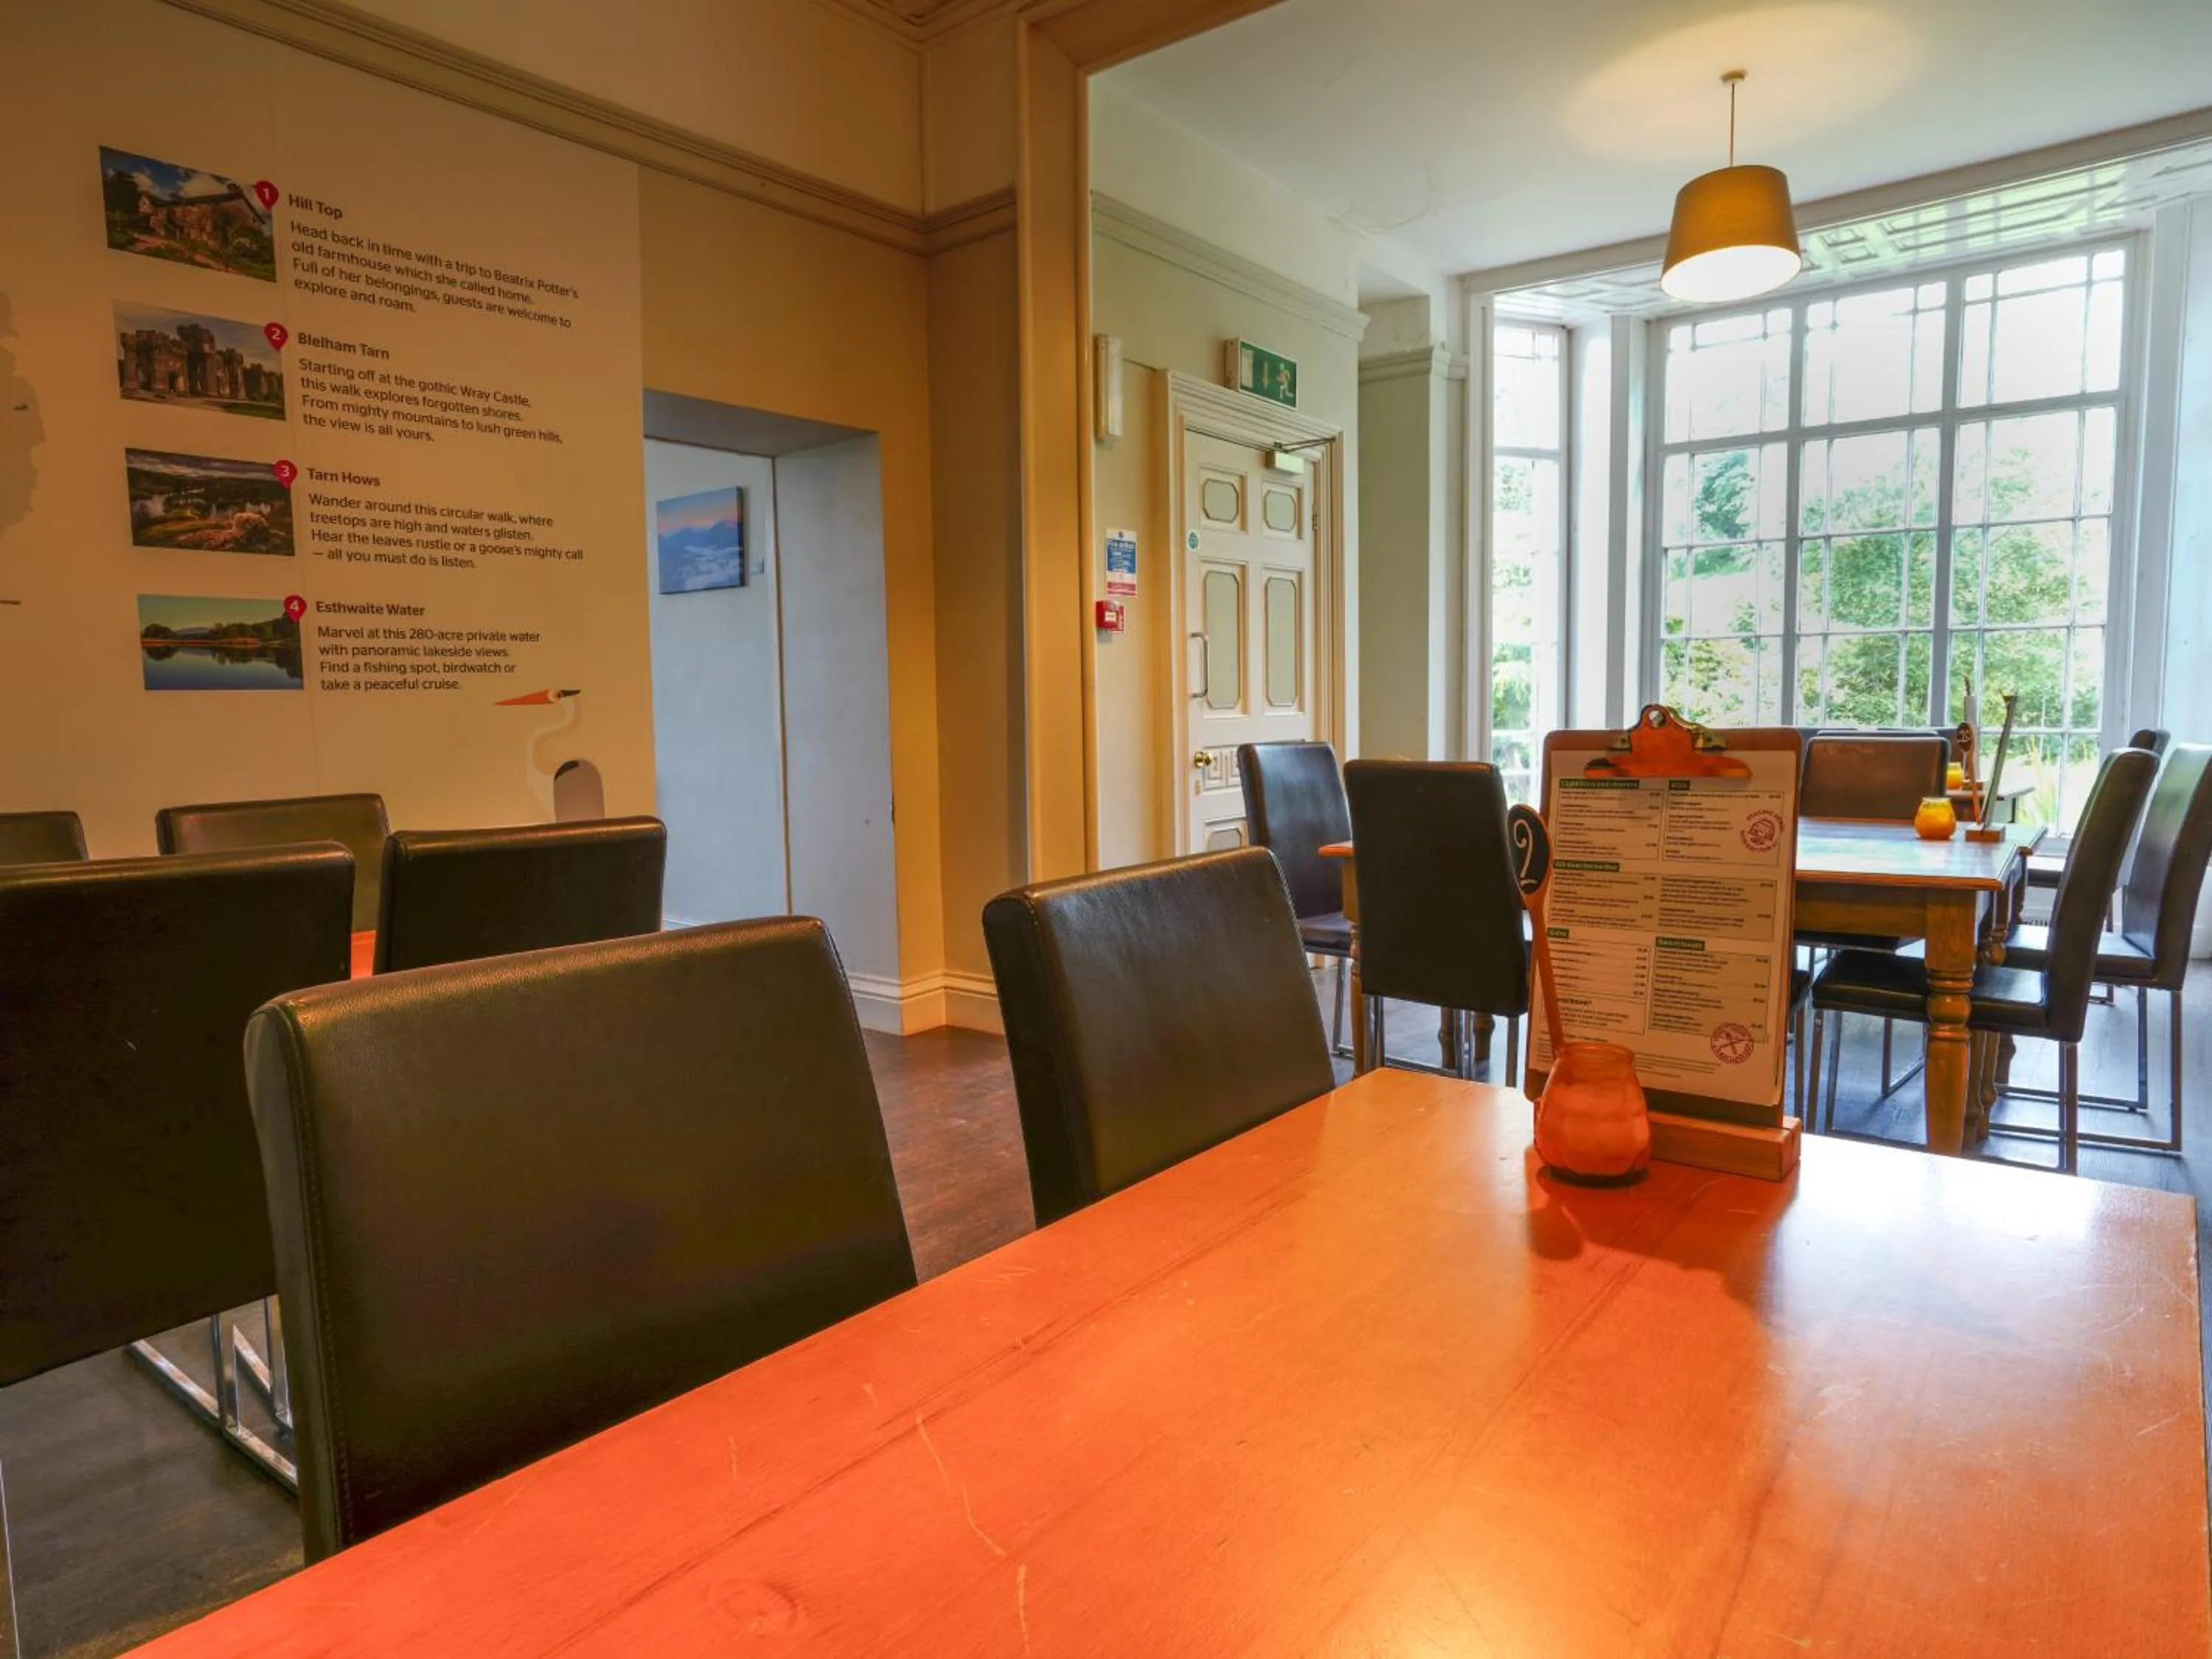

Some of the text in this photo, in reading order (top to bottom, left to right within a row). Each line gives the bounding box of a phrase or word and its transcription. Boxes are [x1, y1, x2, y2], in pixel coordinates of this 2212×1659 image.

[262, 187, 271, 201] 1
[288, 193, 343, 220] Hill Top
[291, 220, 579, 299] Head back in time with a trip to Beatrix Potter's
[291, 240, 535, 305] old farmhouse which she called home.
[293, 257, 572, 328] Full of her belongings, guests are welcome to
[294, 278, 416, 313] explore and roam.
[271, 328, 281, 341] 2
[297, 332, 390, 360] Blelham Tarn
[299, 358, 532, 408] Starting off at the gothic Wray Castle,
[300, 377, 524, 422] this walk explores forgotten shores.
[301, 394, 338, 411] From
[341, 402, 389, 420] mighty
[392, 410, 459, 429] mountains
[461, 418, 474, 431] to
[476, 420, 501, 434] lush
[502, 426, 536, 440] green
[302, 413, 435, 442] the view is all yours.
[281, 465, 291, 478] 3
[306, 467, 381, 487] Tarn Hows
[307, 493, 362, 509] Wander
[364, 501, 412, 514] around
[414, 504, 437, 517] this
[439, 507, 484, 521] circular
[518, 514, 554, 527] where
[310, 511, 534, 541] treetops are high and waters glisten.
[310, 528, 583, 562] Hear the leaves rustle or a goose's mighty call
[327, 548, 343, 560] all
[345, 551, 371, 563] you
[373, 552, 407, 564] must
[410, 553, 427, 566] do
[428, 554, 439, 566] is
[290, 601, 299, 613] 4
[316, 601, 425, 616] Esthwaite Water
[318, 625, 541, 644] Marvel at this 280-acre private water
[318, 643, 349, 655] with
[351, 644, 421, 658] panoramic
[422, 644, 473, 656] lakeside
[319, 660, 517, 677] Find a fishing spot, birdwatch or
[320, 678, 350, 692] take
[352, 681, 362, 691] a
[364, 678, 420, 694] peaceful
